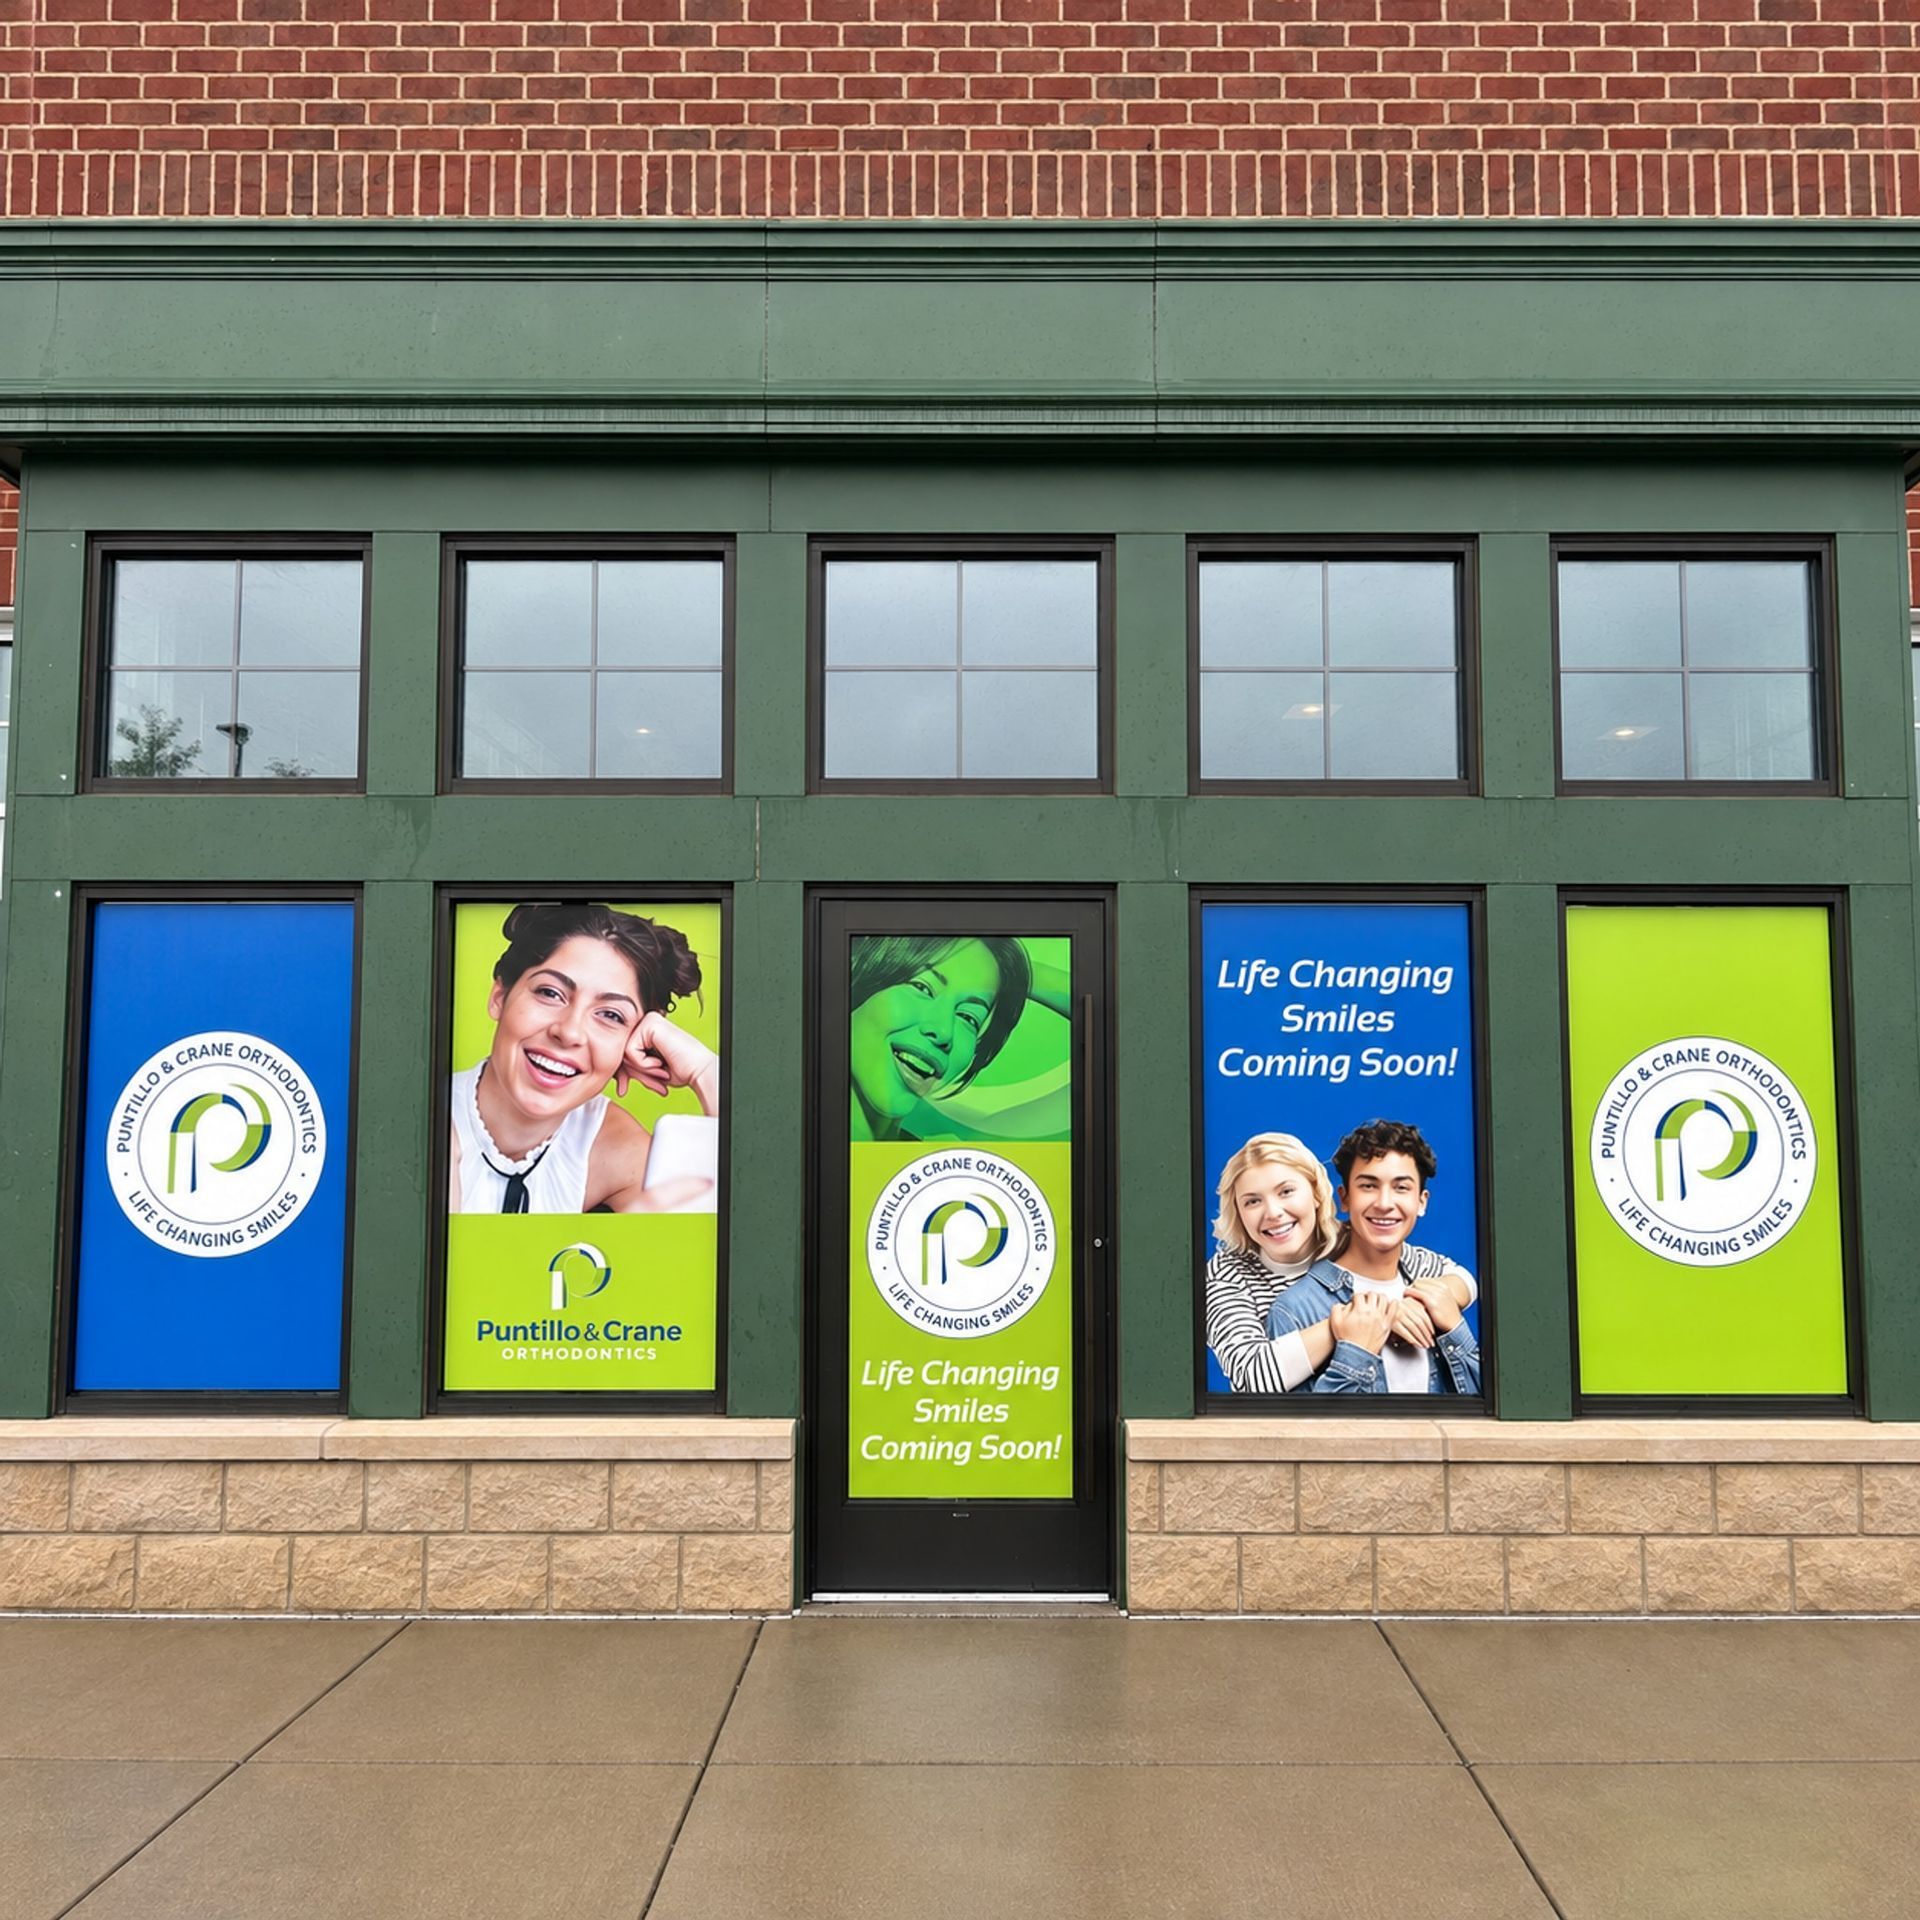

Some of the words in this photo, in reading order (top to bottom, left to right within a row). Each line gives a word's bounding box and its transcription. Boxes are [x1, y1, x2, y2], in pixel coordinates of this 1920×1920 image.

[1218, 960, 1280, 995] Life
[1289, 960, 1453, 995] Changing
[1281, 1004, 1395, 1032] Smiles
[1218, 1048, 1351, 1083] Coming
[1359, 1047, 1458, 1076] Soon!
[117, 1071, 160, 1153] PUNTILLO
[161, 1061, 175, 1074] &
[175, 1042, 234, 1066] CRANE
[238, 1045, 316, 1154] ORTHODONTICS
[1601, 1078, 1639, 1159] PUNTILLO
[1638, 1067, 1653, 1081] &
[1652, 1048, 1710, 1072] CRANE
[1716, 1050, 1806, 1160] ORTHODONTICS
[128, 1190, 158, 1223] LIFE
[156, 1218, 245, 1247] CHANGING
[247, 1191, 298, 1239] SMILES
[875, 1182, 910, 1251] PUNTILLO
[911, 1173, 922, 1184] &
[923, 1157, 972, 1177] CRANE
[976, 1160, 1047, 1251] ORTHODONTICS
[1618, 1198, 1650, 1231] LIFE
[1649, 1226, 1741, 1256] CHANGING
[1743, 1198, 1793, 1247] SMILES
[888, 1283, 915, 1310] LIFE
[914, 1306, 990, 1330] CHANGING
[992, 1284, 1034, 1322] SMILES
[477, 1320, 580, 1342] Puntillo
[584, 1322, 600, 1342] &
[603, 1320, 682, 1342] Crane
[501, 1347, 657, 1360] ORTHODONTICS
[862, 1360, 913, 1391] Life
[921, 1360, 1059, 1391] Changing
[914, 1398, 1009, 1423] Smiles
[861, 1435, 972, 1466] Coming
[980, 1434, 1062, 1461] Soon!
